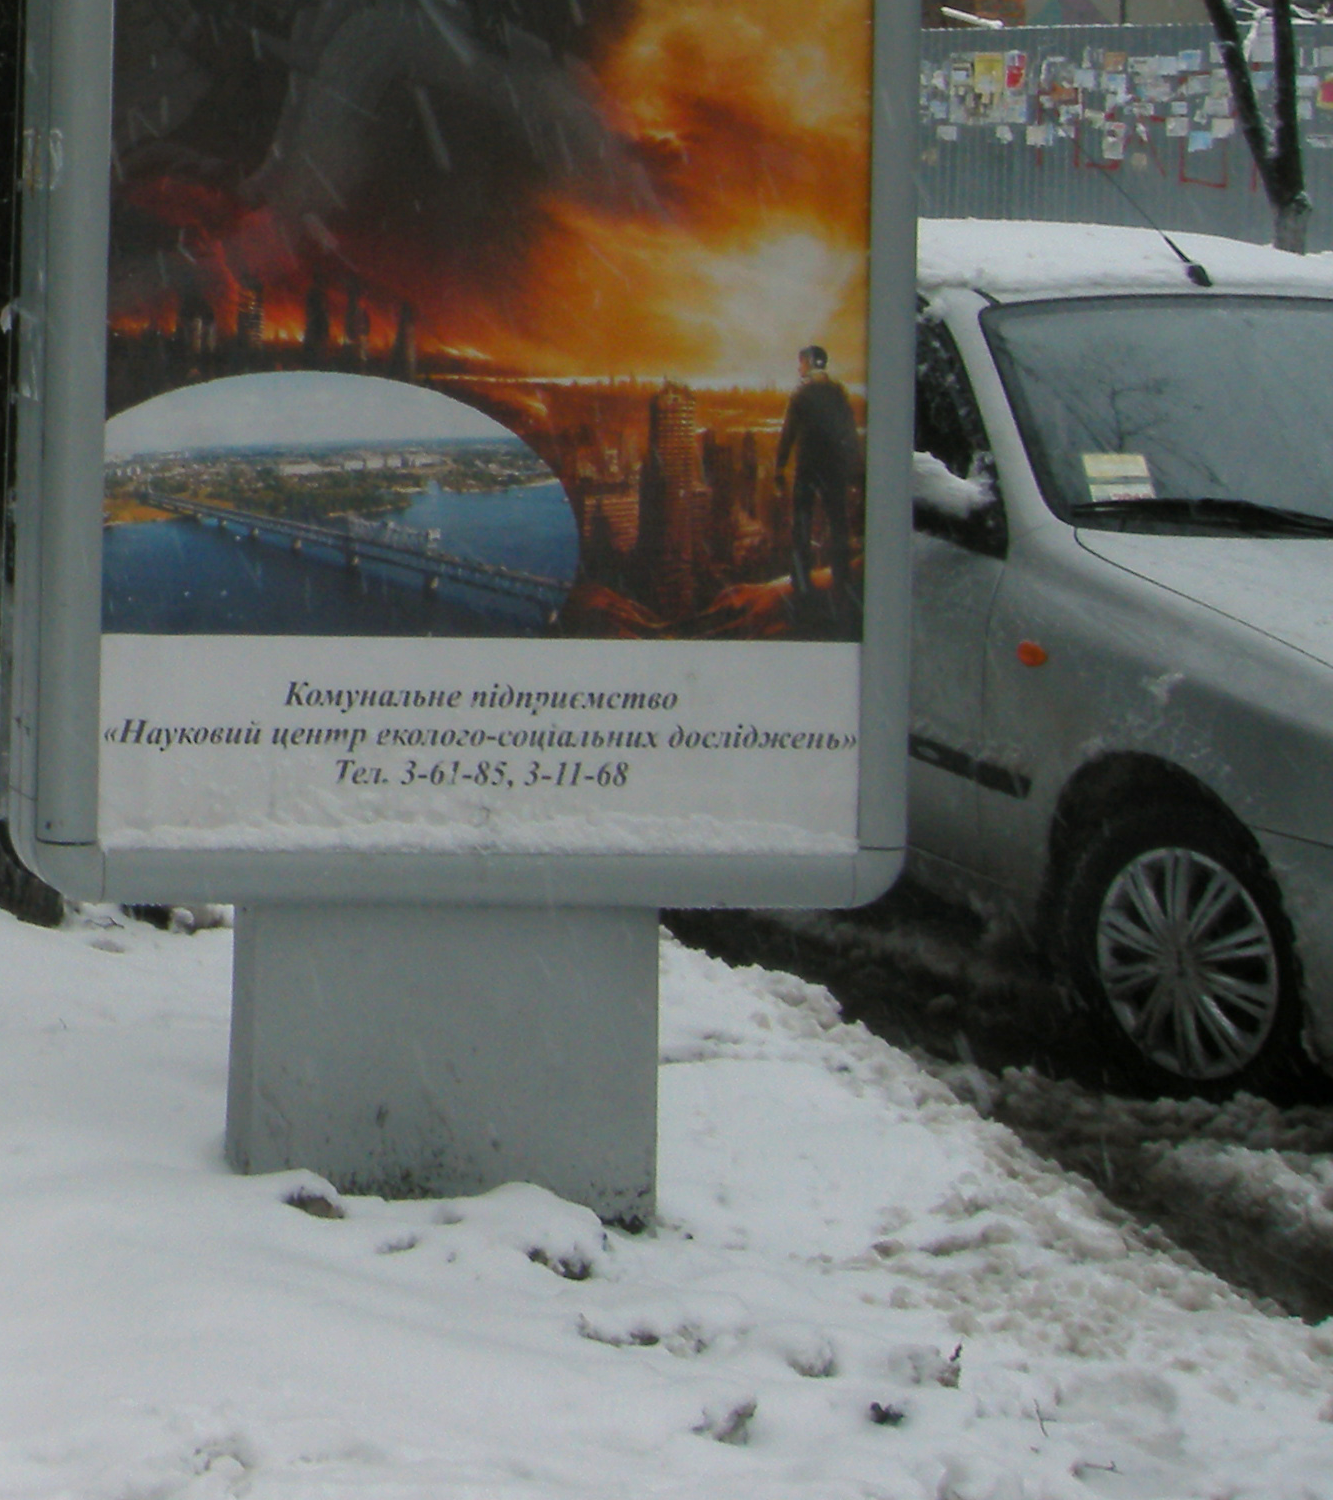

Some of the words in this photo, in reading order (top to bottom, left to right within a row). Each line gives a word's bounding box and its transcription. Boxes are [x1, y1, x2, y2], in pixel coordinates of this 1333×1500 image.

[284, 681, 463, 714] Комунальне
[471, 683, 679, 716] підприємство
[104, 719, 264, 752] «Науковий
[271, 726, 368, 752] центр
[375, 724, 659, 753] еколого-соціальних
[668, 723, 858, 751] досліджень»
[334, 758, 389, 786] Тел.
[400, 759, 515, 789] 3-61-85,
[523, 759, 630, 788] 3-11-68
